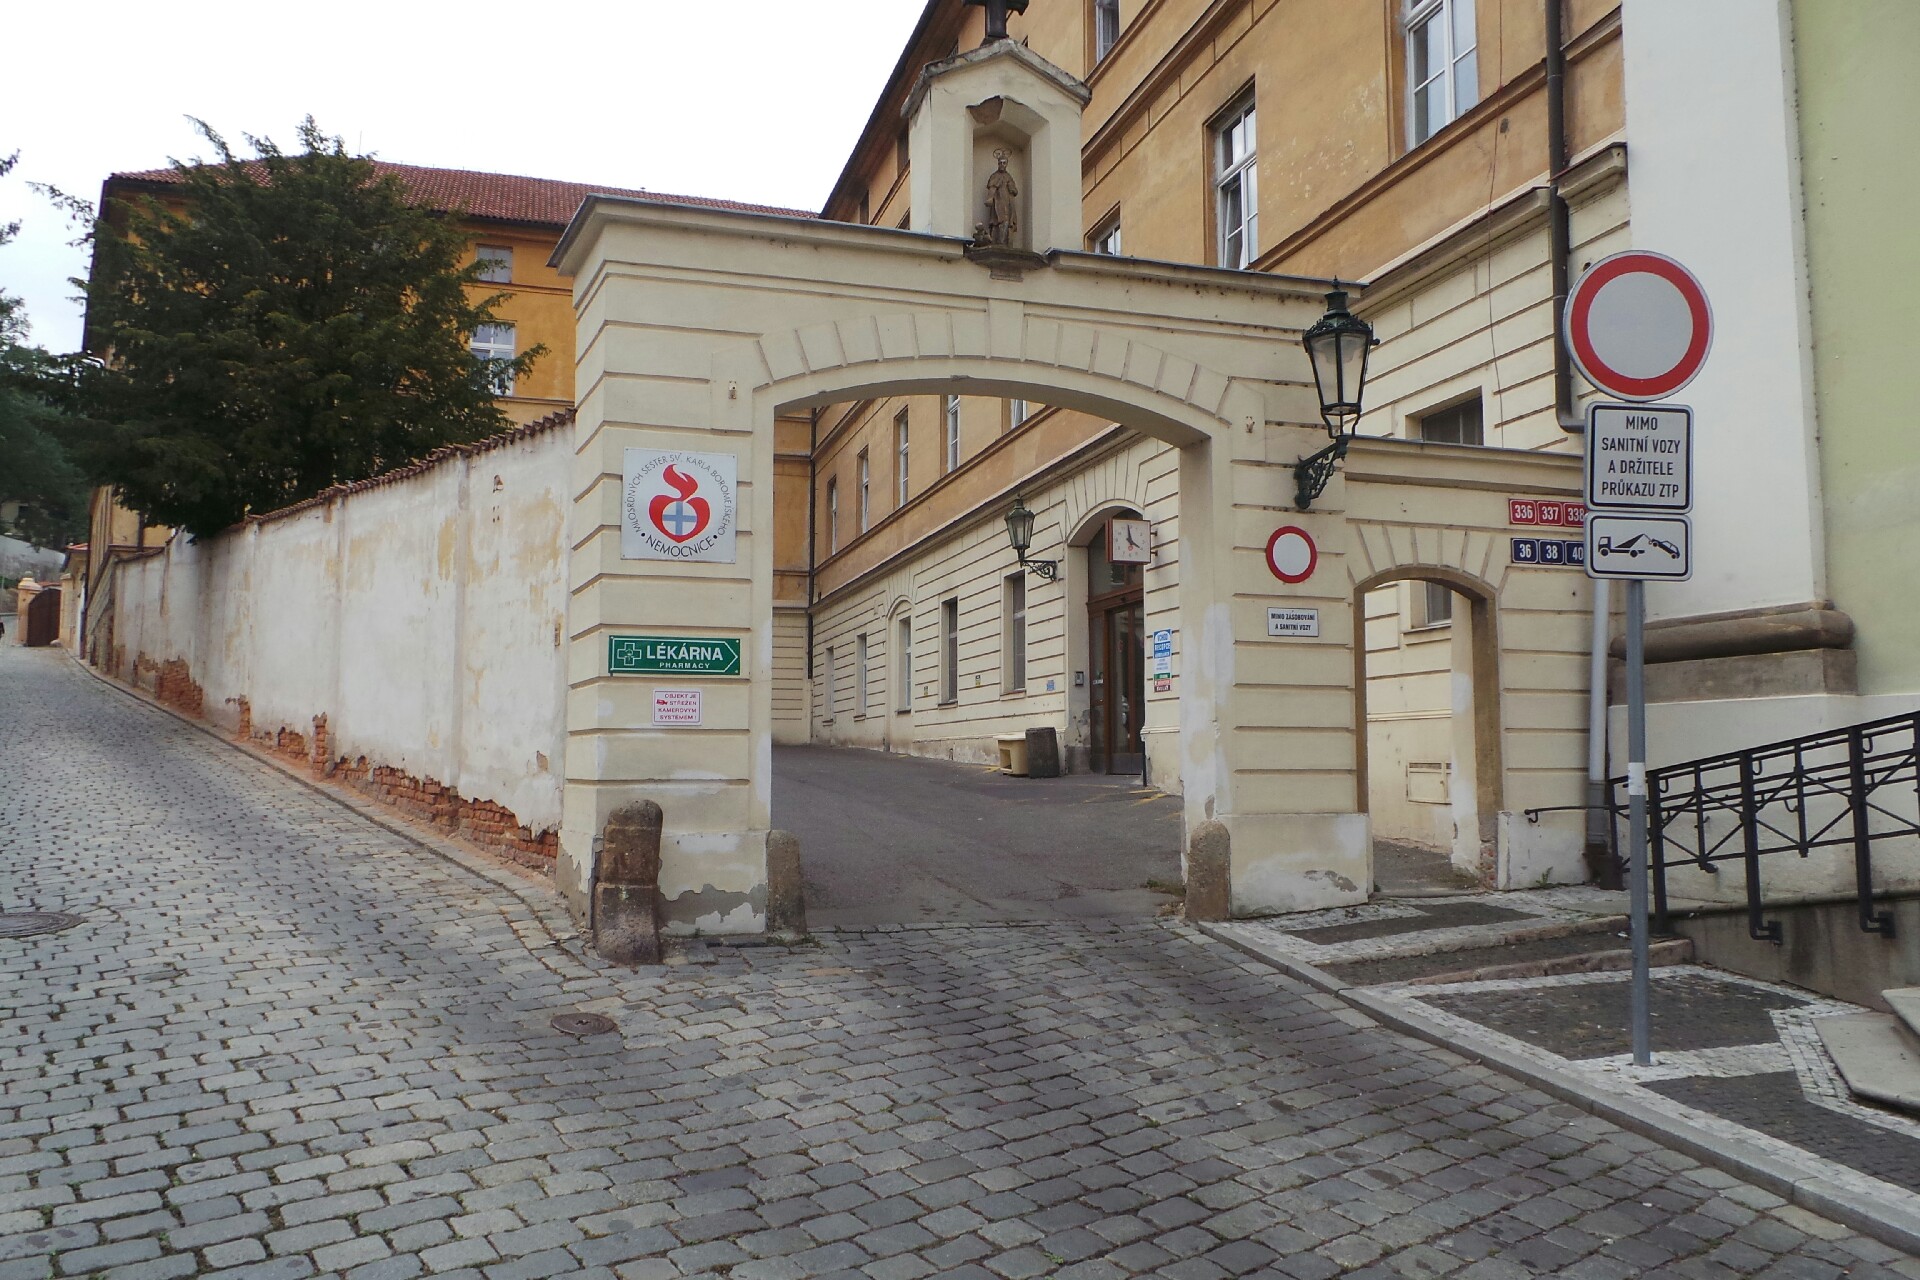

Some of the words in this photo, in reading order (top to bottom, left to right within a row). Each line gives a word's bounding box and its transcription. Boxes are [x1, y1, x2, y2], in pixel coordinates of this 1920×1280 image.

[1625, 415, 1658, 430] MIMO
[1601, 436, 1648, 453] SANITNÍ
[1652, 439, 1681, 454] VOZY
[641, 455, 668, 475] SESTER
[686, 456, 711, 472] KARLA
[1608, 459, 1616, 474] A
[1620, 458, 1674, 476] DRŽITELE
[1601, 479, 1656, 497] PRŮKAZU
[1659, 483, 1679, 498] ZTP
[1514, 504, 1533, 519] 336
[1541, 506, 1559, 520] 337
[1567, 507, 1584, 521] 338
[645, 534, 715, 557] NEMOCNICE
[1519, 543, 1532, 558] 36
[1545, 544, 1558, 559] 38
[1572, 546, 1584, 560] 40
[646, 642, 723, 661] LÉKÁRNA
[659, 661, 710, 669] PHARMACY
